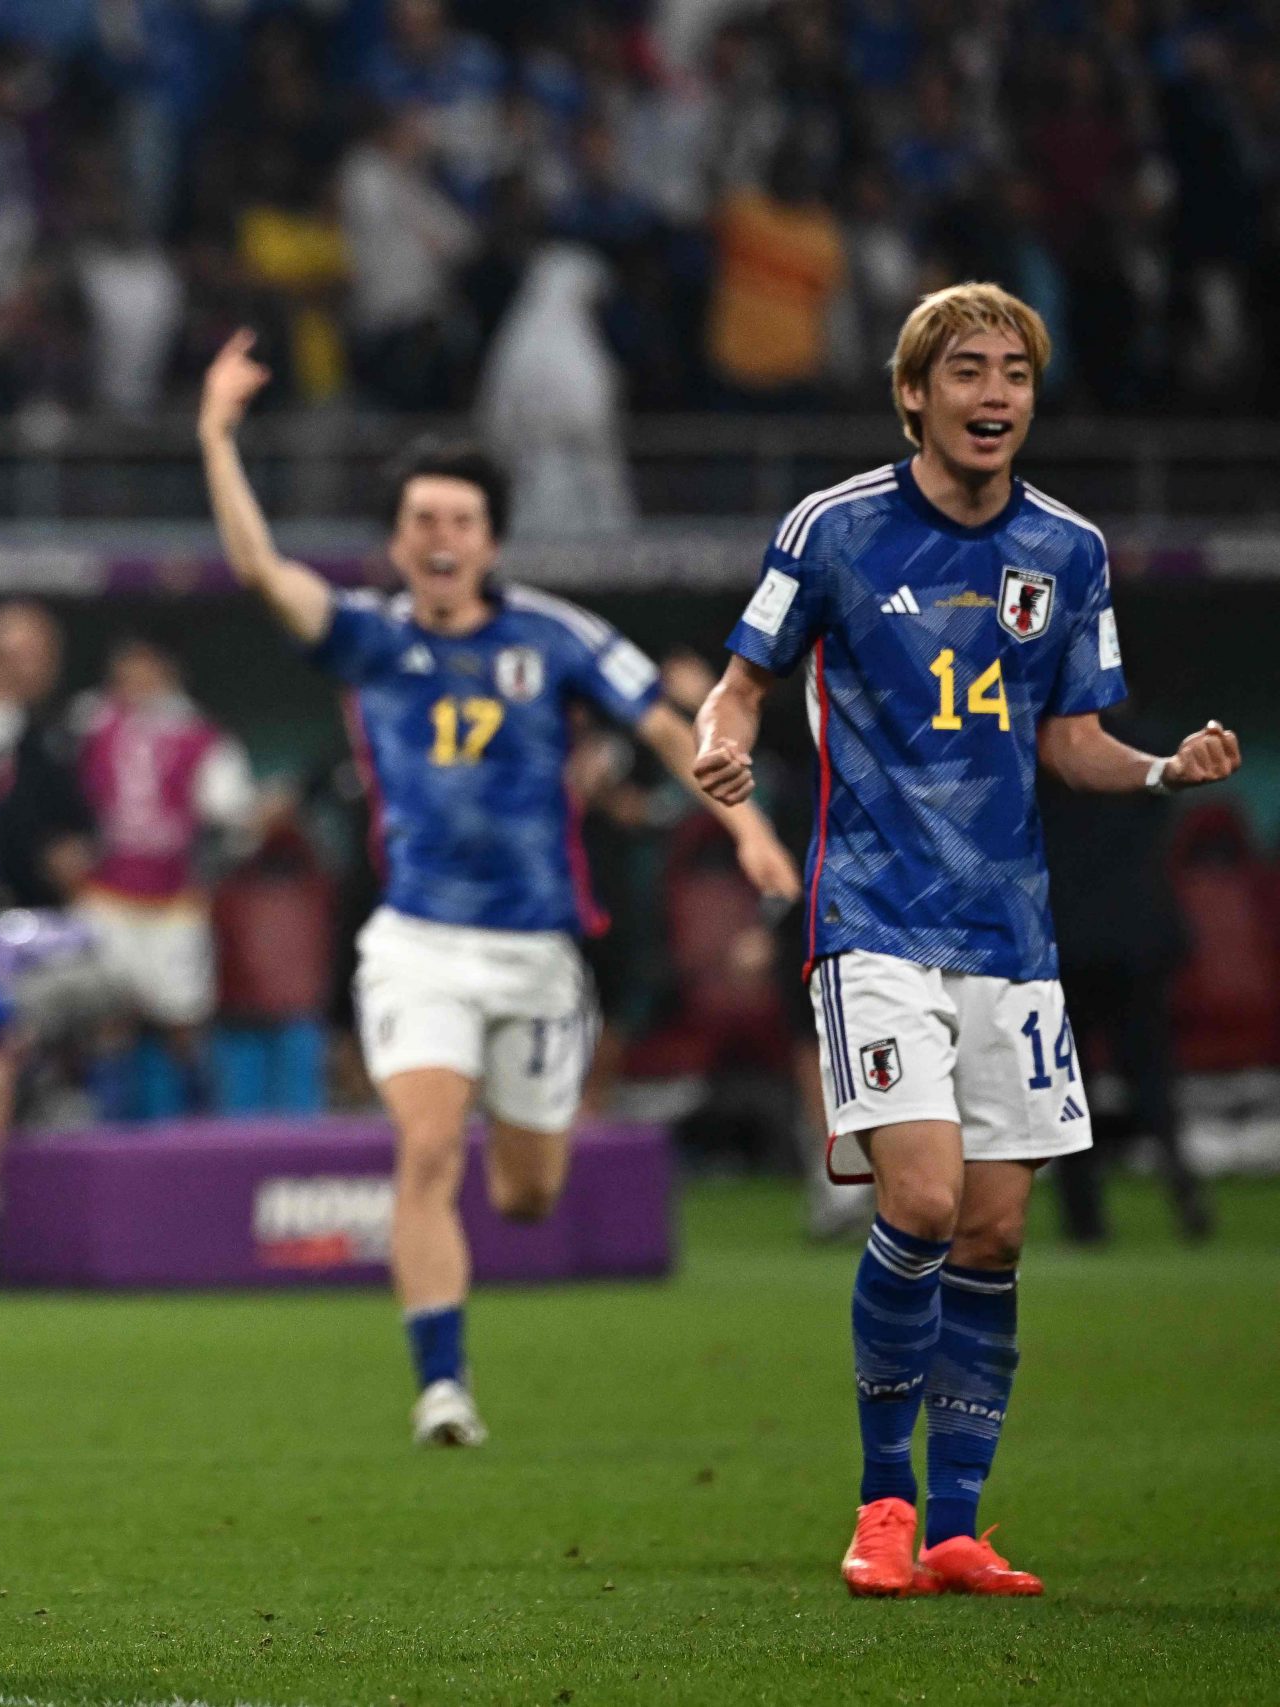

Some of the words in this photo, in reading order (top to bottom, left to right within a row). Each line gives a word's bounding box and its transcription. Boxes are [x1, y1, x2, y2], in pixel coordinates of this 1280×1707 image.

[928, 648, 1010, 732] 14
[427, 695, 504, 767] 17
[1020, 1008, 1076, 1090] 14
[933, 1396, 1006, 1422] JAPA
